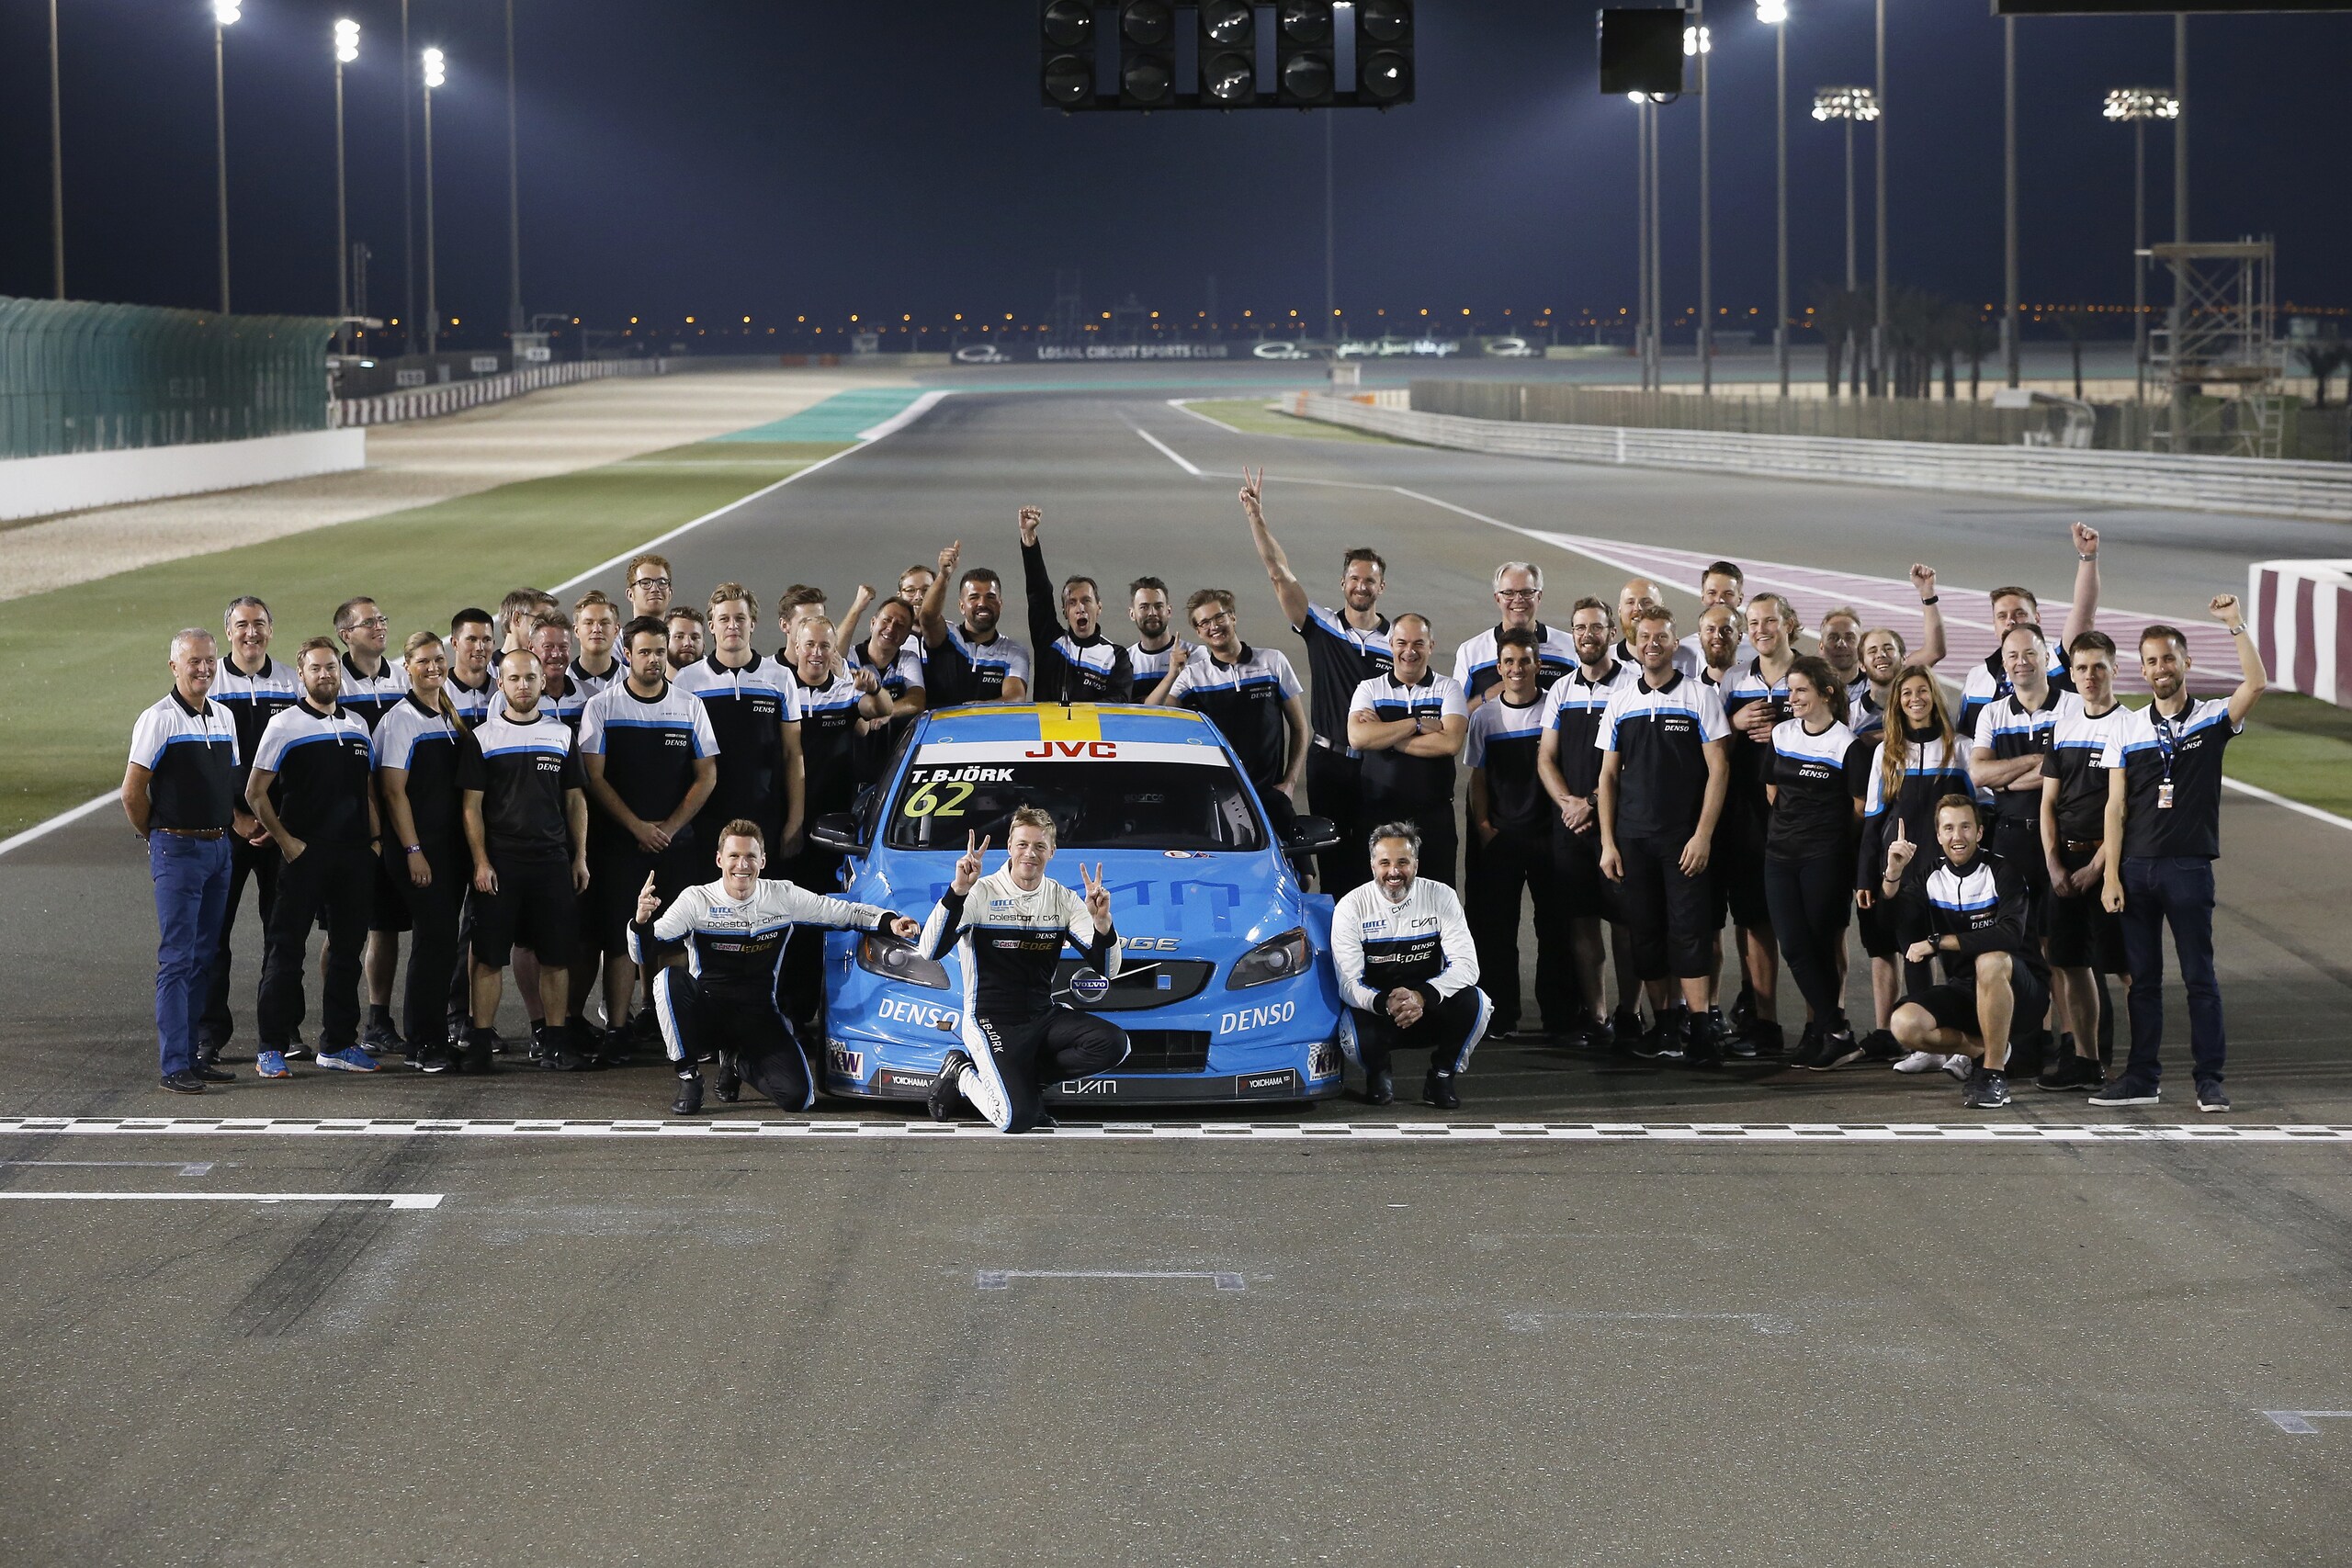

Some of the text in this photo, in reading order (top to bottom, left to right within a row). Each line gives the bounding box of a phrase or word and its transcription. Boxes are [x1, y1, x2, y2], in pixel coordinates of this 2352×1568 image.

[1087, 345, 1137, 358] CIRCUIT
[1140, 345, 1192, 358] SPORTS
[1193, 345, 1227, 357] CLUB
[1025, 741, 1116, 758] JVC
[537, 763, 561, 773] DENSO
[1799, 769, 1829, 779] DENSO
[904, 781, 975, 818] 62
[1972, 918, 1997, 930] DENS
[757, 931, 778, 942] DENSO
[718, 942, 740, 951] Castrol
[1020, 942, 1054, 950] EDGE
[1118, 937, 1181, 951] DGE
[1411, 942, 1435, 951] DENSO
[1374, 951, 1431, 964] Castrol EDGE
[879, 998, 960, 1031] DENSO
[1220, 1000, 1295, 1034] DENSO
[892, 1076, 929, 1088] YOKOHAMA
[1250, 1077, 1283, 1088] YOKOHAMA
